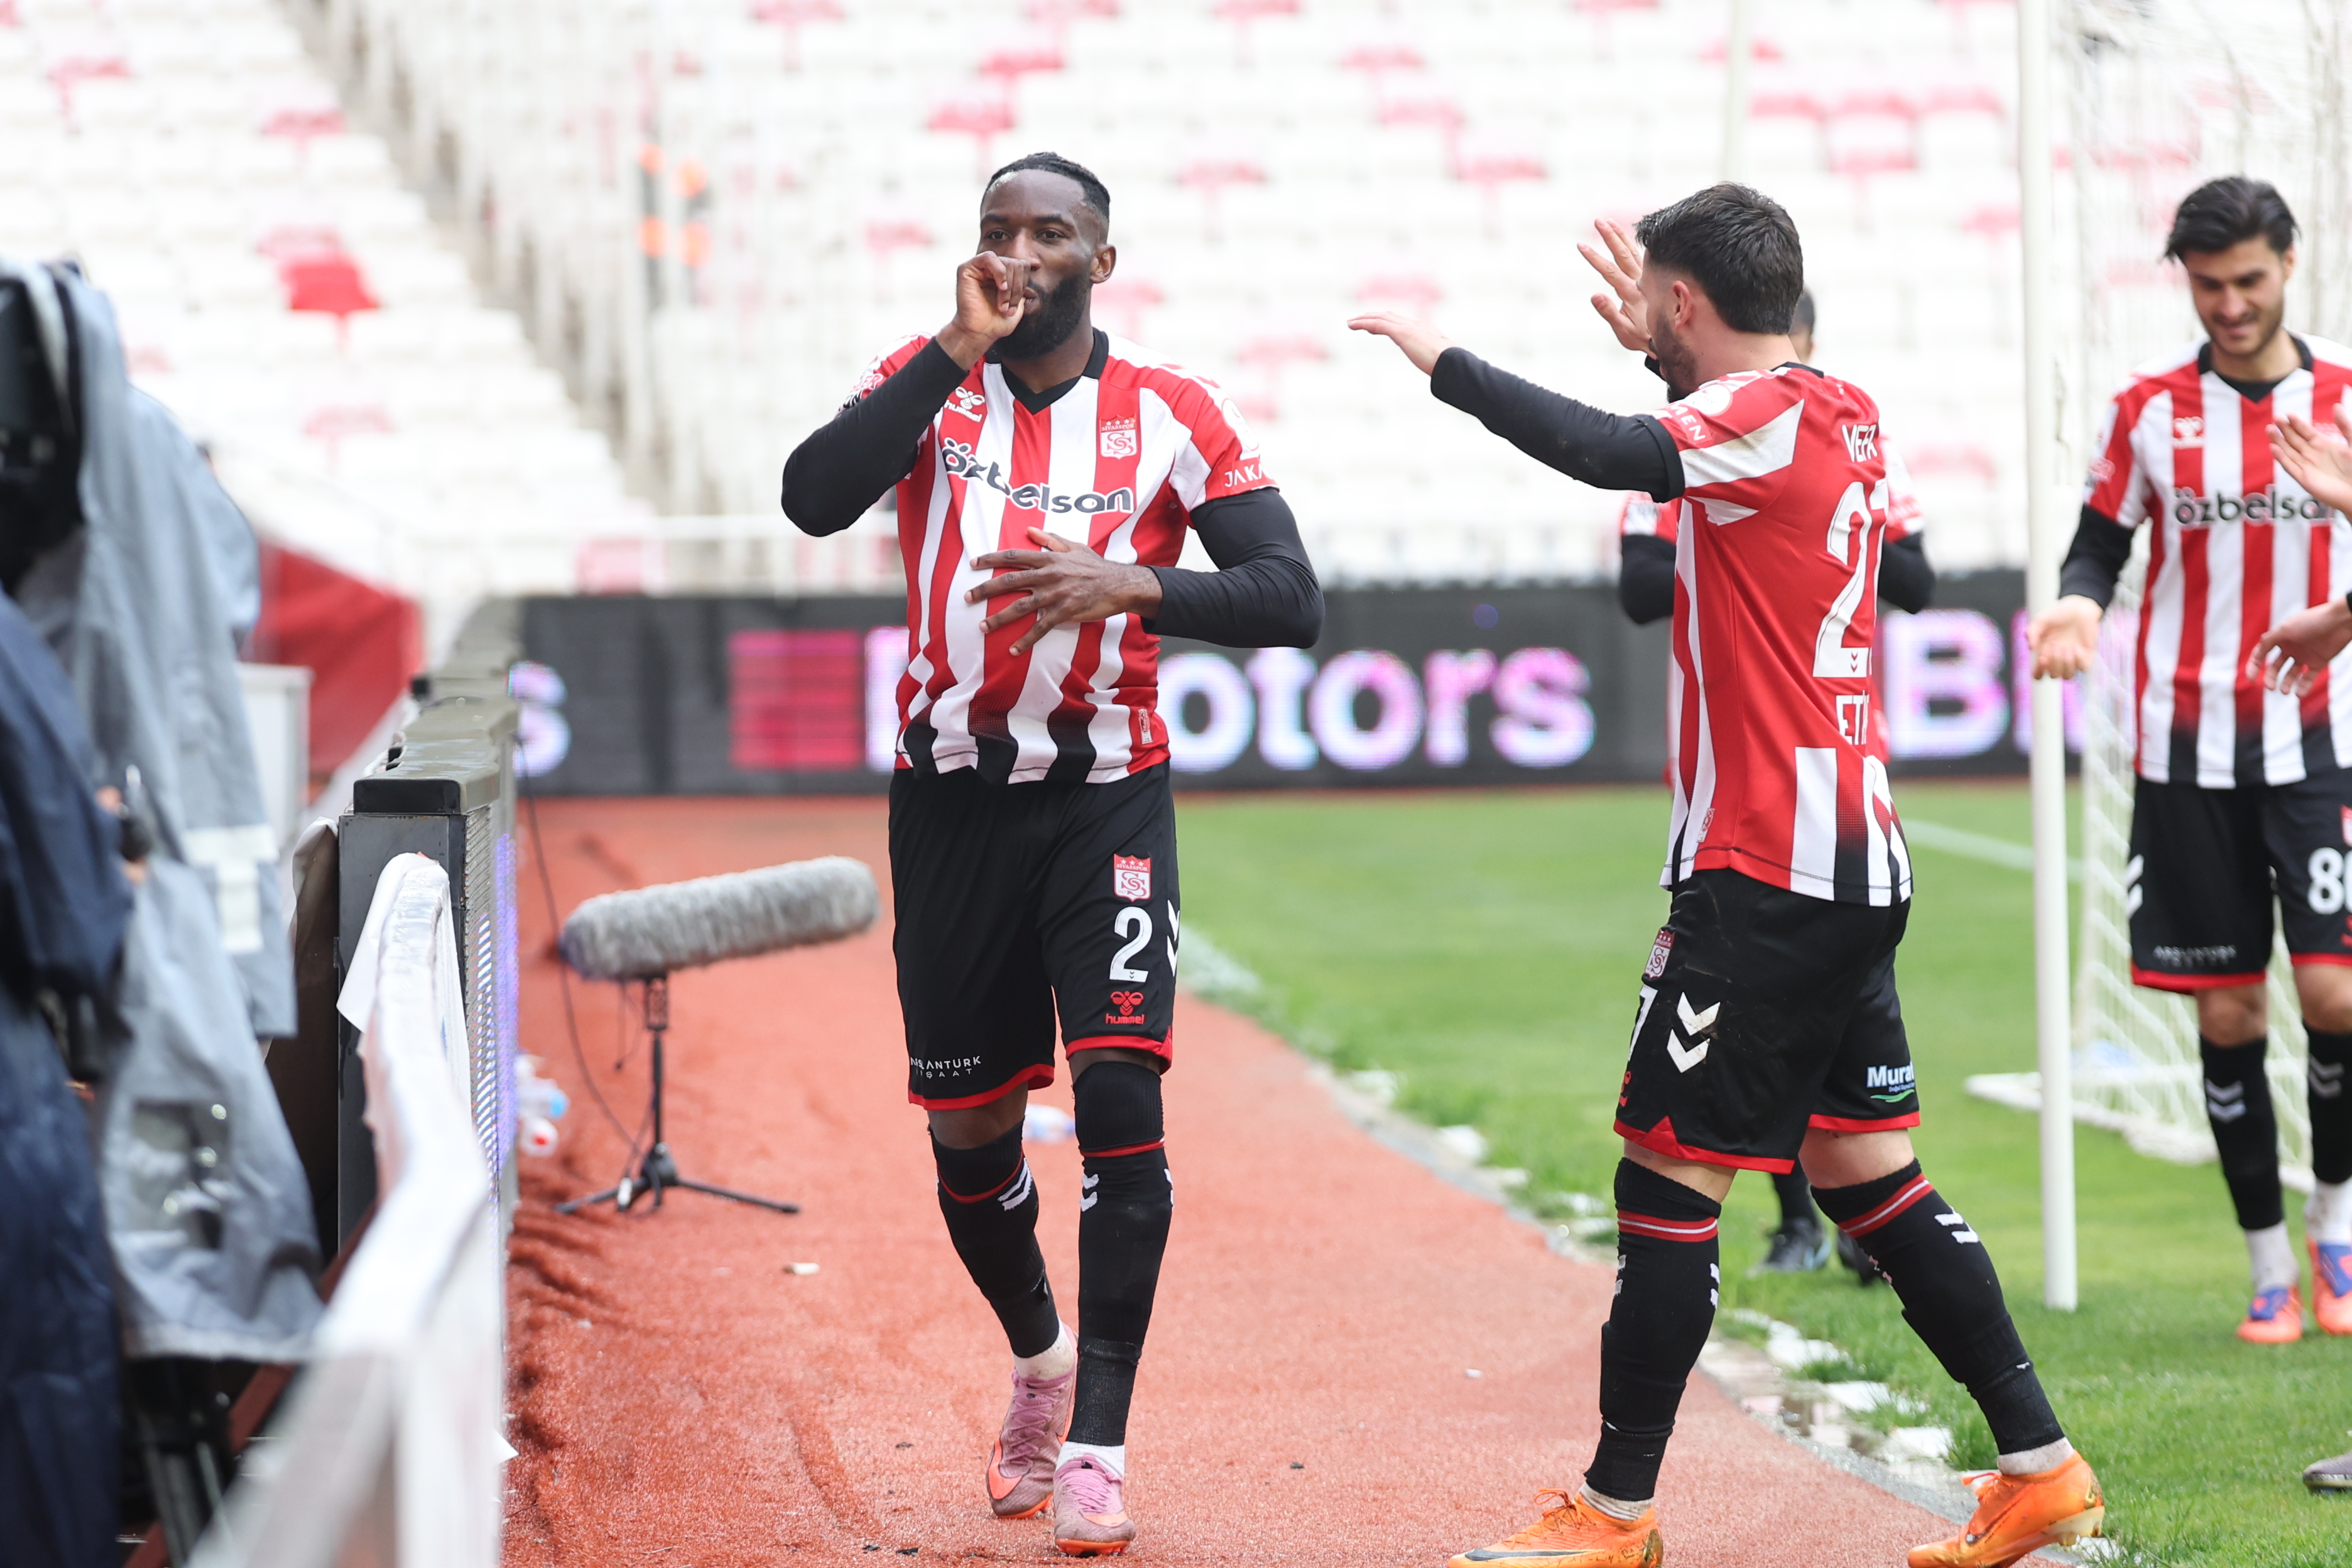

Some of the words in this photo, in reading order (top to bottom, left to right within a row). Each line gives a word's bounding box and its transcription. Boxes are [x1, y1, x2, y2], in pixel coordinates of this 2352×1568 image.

[944, 399, 983, 422] hummel
[2174, 487, 2330, 525] özbelsa
[1157, 646, 1597, 774] otors
[2307, 847, 2352, 915] 8
[1109, 906, 1153, 983] 2
[1105, 1013, 1145, 1025] hummel
